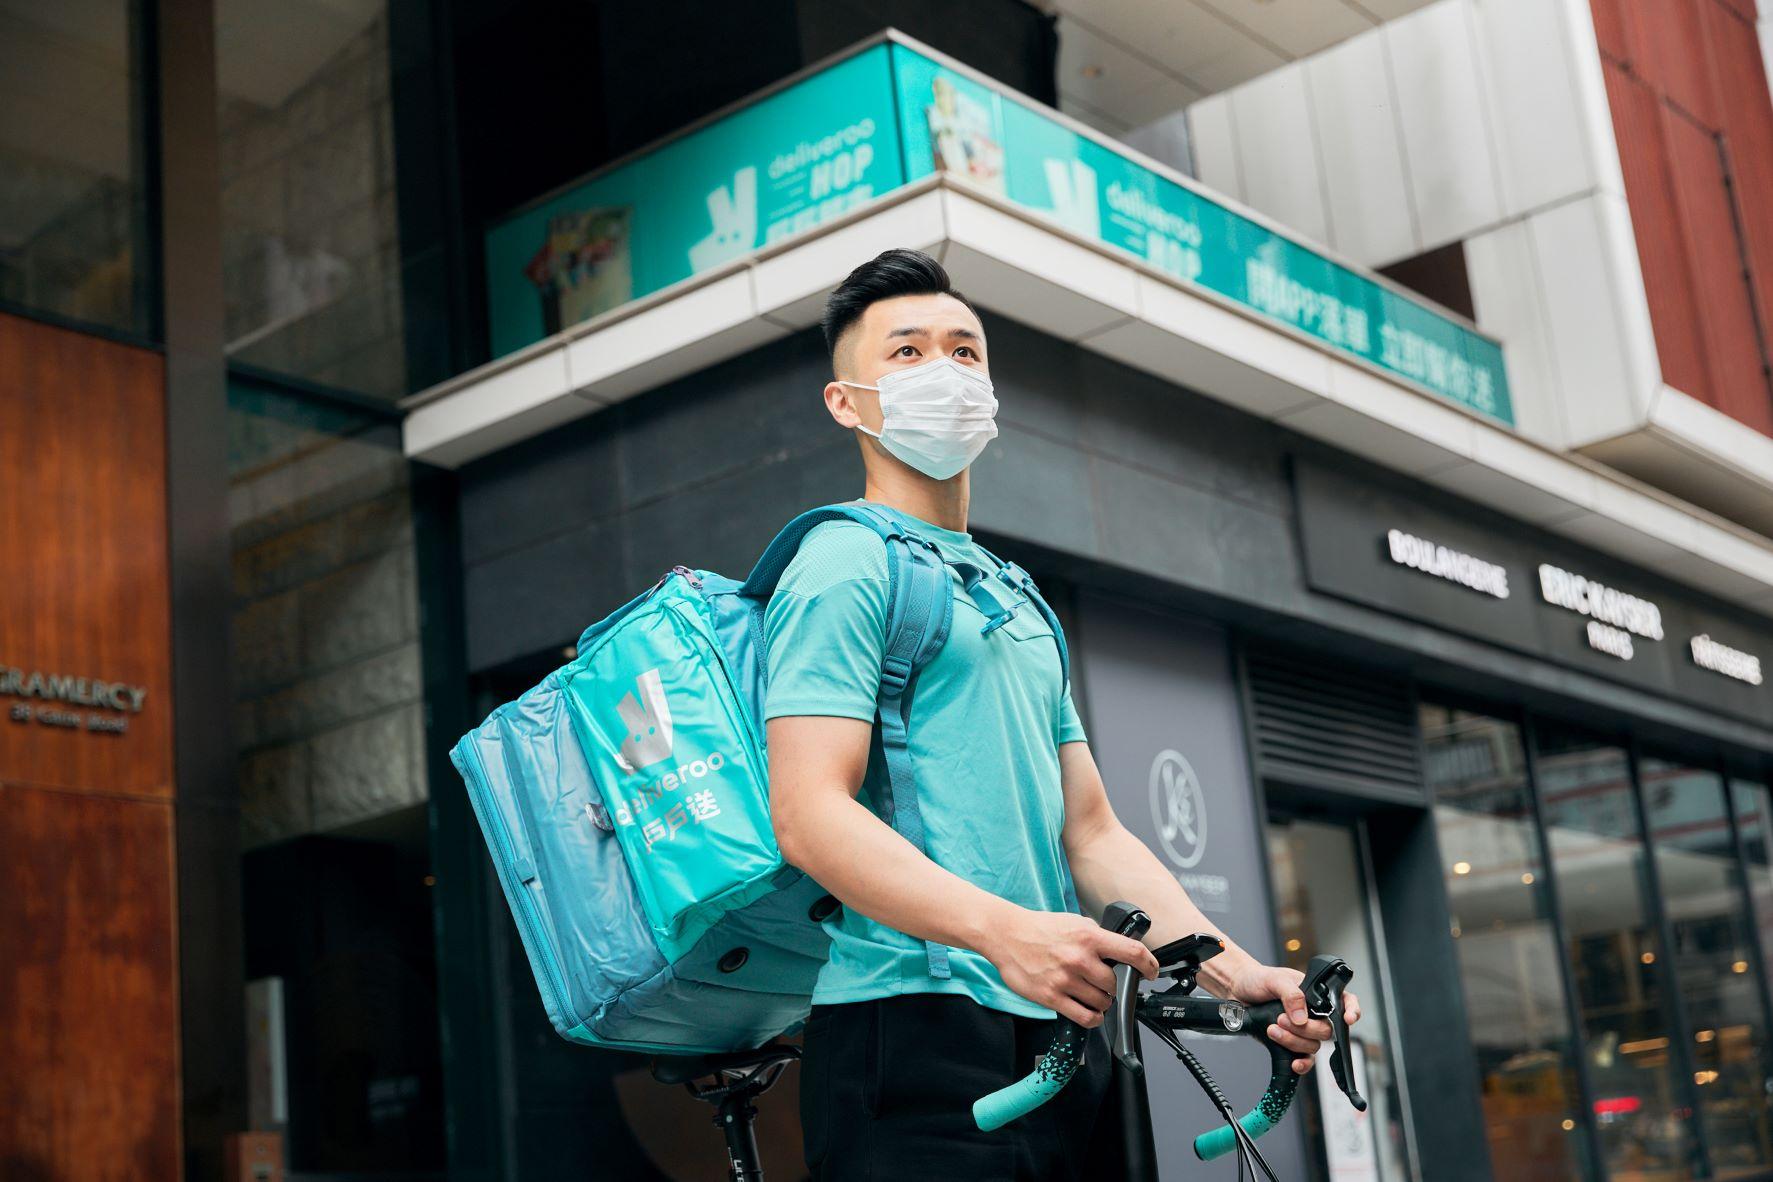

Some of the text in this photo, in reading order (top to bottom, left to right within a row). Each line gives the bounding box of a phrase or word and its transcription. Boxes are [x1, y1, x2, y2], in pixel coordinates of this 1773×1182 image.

[767, 117, 876, 179] deliveroo
[809, 143, 874, 200] HOP
[616, 751, 725, 826] deliveroo
